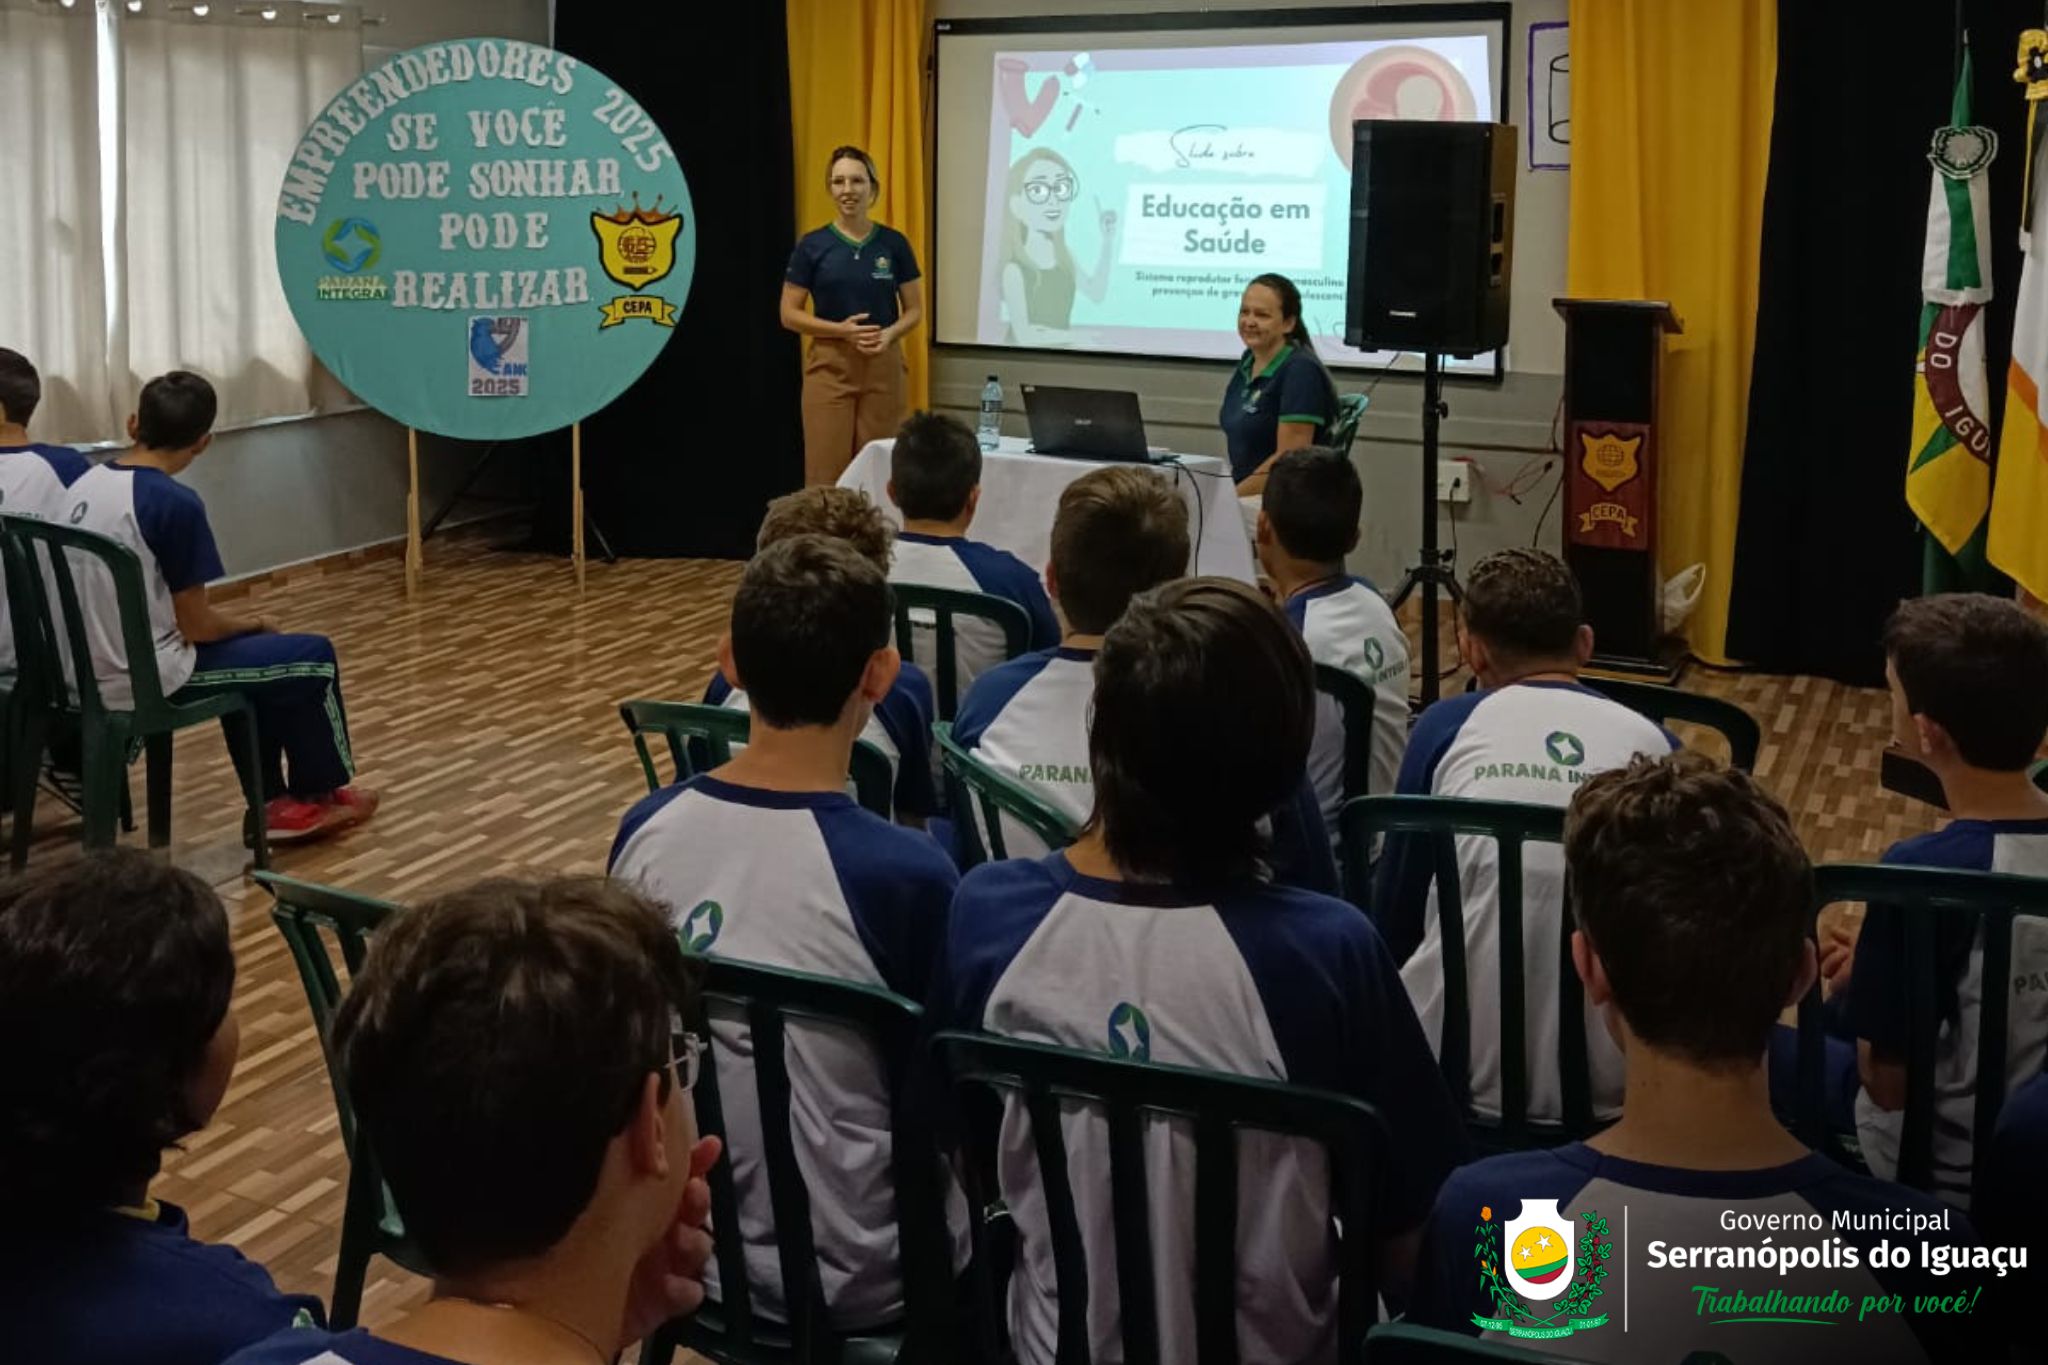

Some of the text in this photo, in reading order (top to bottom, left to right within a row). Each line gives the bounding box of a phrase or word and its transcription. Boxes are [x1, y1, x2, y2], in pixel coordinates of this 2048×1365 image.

[278, 40, 675, 226] EMPREENDEDORES 2025
[386, 101, 568, 151] SE VOCÊ
[353, 159, 622, 200] PODE SONHAR
[1142, 194, 1311, 226] Educação em
[440, 212, 549, 251] PODE
[1184, 228, 1267, 254] Saúde
[392, 267, 590, 310] REALIZAR
[623, 301, 653, 314] CEPA
[1930, 332, 1957, 369] DO
[471, 378, 521, 395] 2025
[1020, 764, 1092, 784] PARAN
